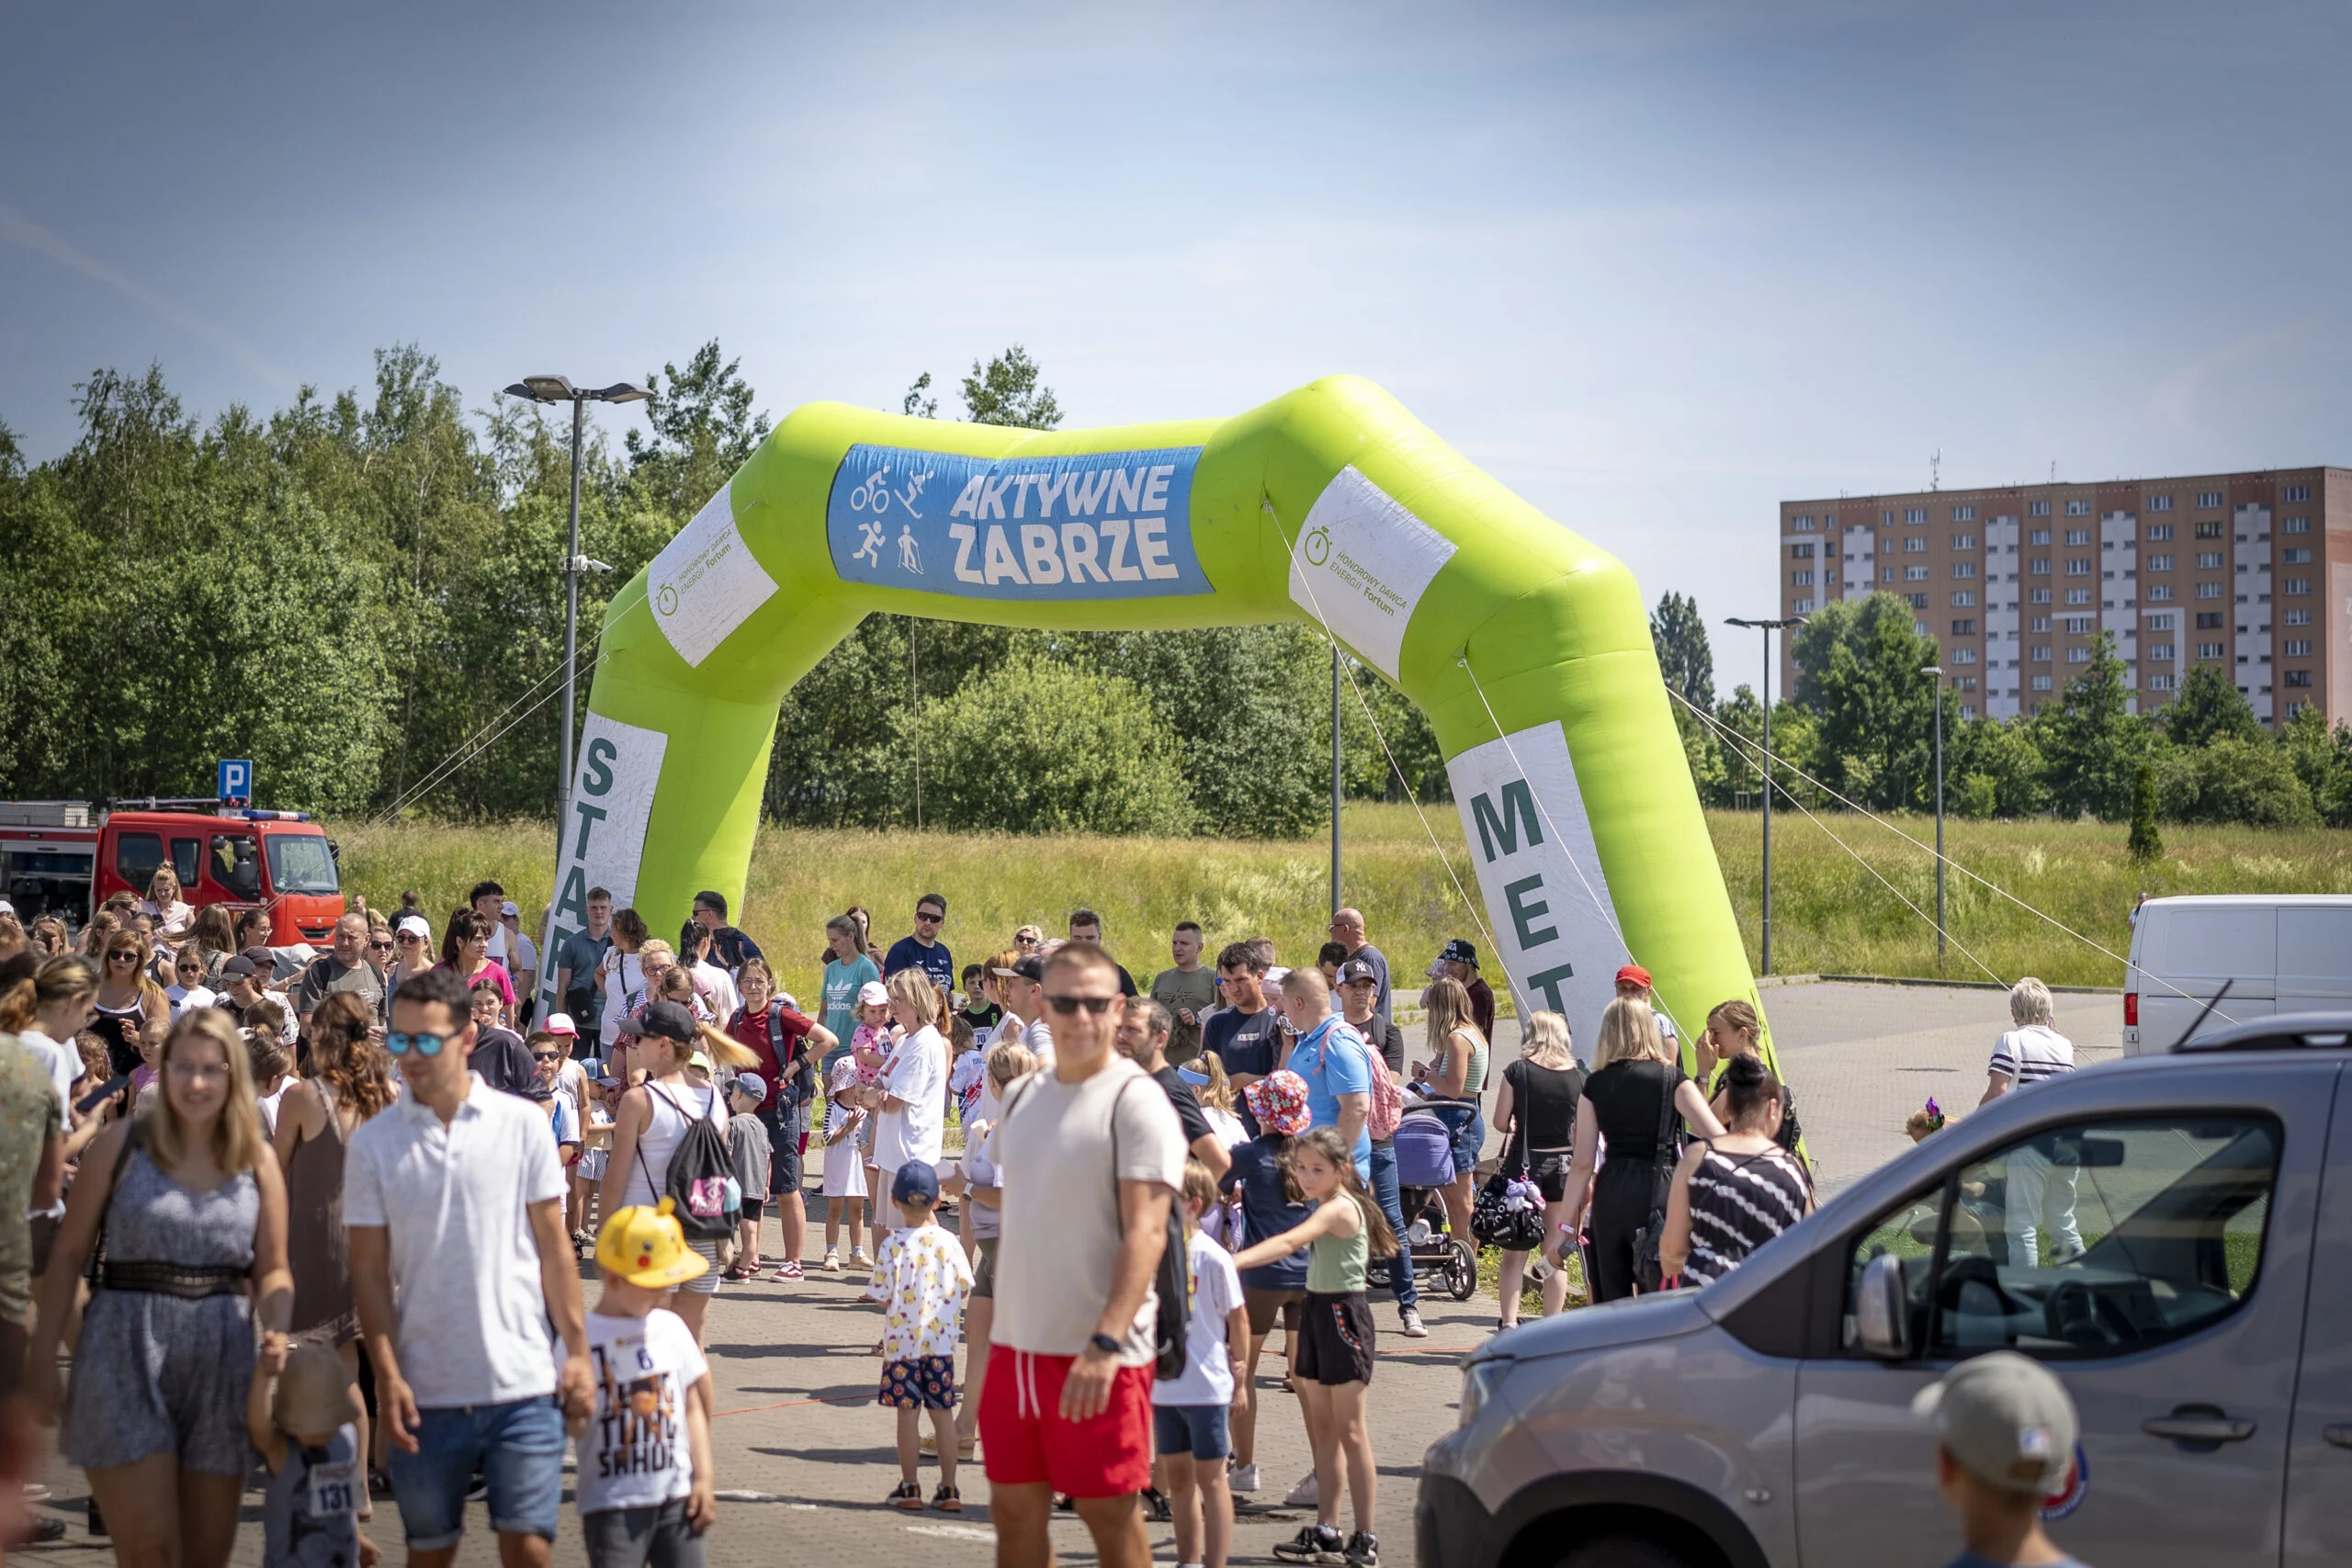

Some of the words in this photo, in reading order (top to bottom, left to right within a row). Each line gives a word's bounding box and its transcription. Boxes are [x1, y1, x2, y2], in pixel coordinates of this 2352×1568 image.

[949, 465, 1175, 520] AKTYWNE
[678, 548, 711, 583] HONOROWY
[710, 528, 732, 552] DAWCA
[680, 568, 705, 595] ENERGII
[706, 543, 731, 570] Fortum
[948, 517, 1180, 585] ZABRZE
[1329, 561, 1363, 592] ENERGII
[1363, 587, 1395, 617] Fortum
[1337, 551, 1381, 588] HONOROWY
[1379, 582, 1408, 610] DAWCA
[226, 764, 244, 795] P
[1470, 778, 1590, 1077] MET
[976, 1034, 987, 1044] 70
[318, 1483, 353, 1511] 131
